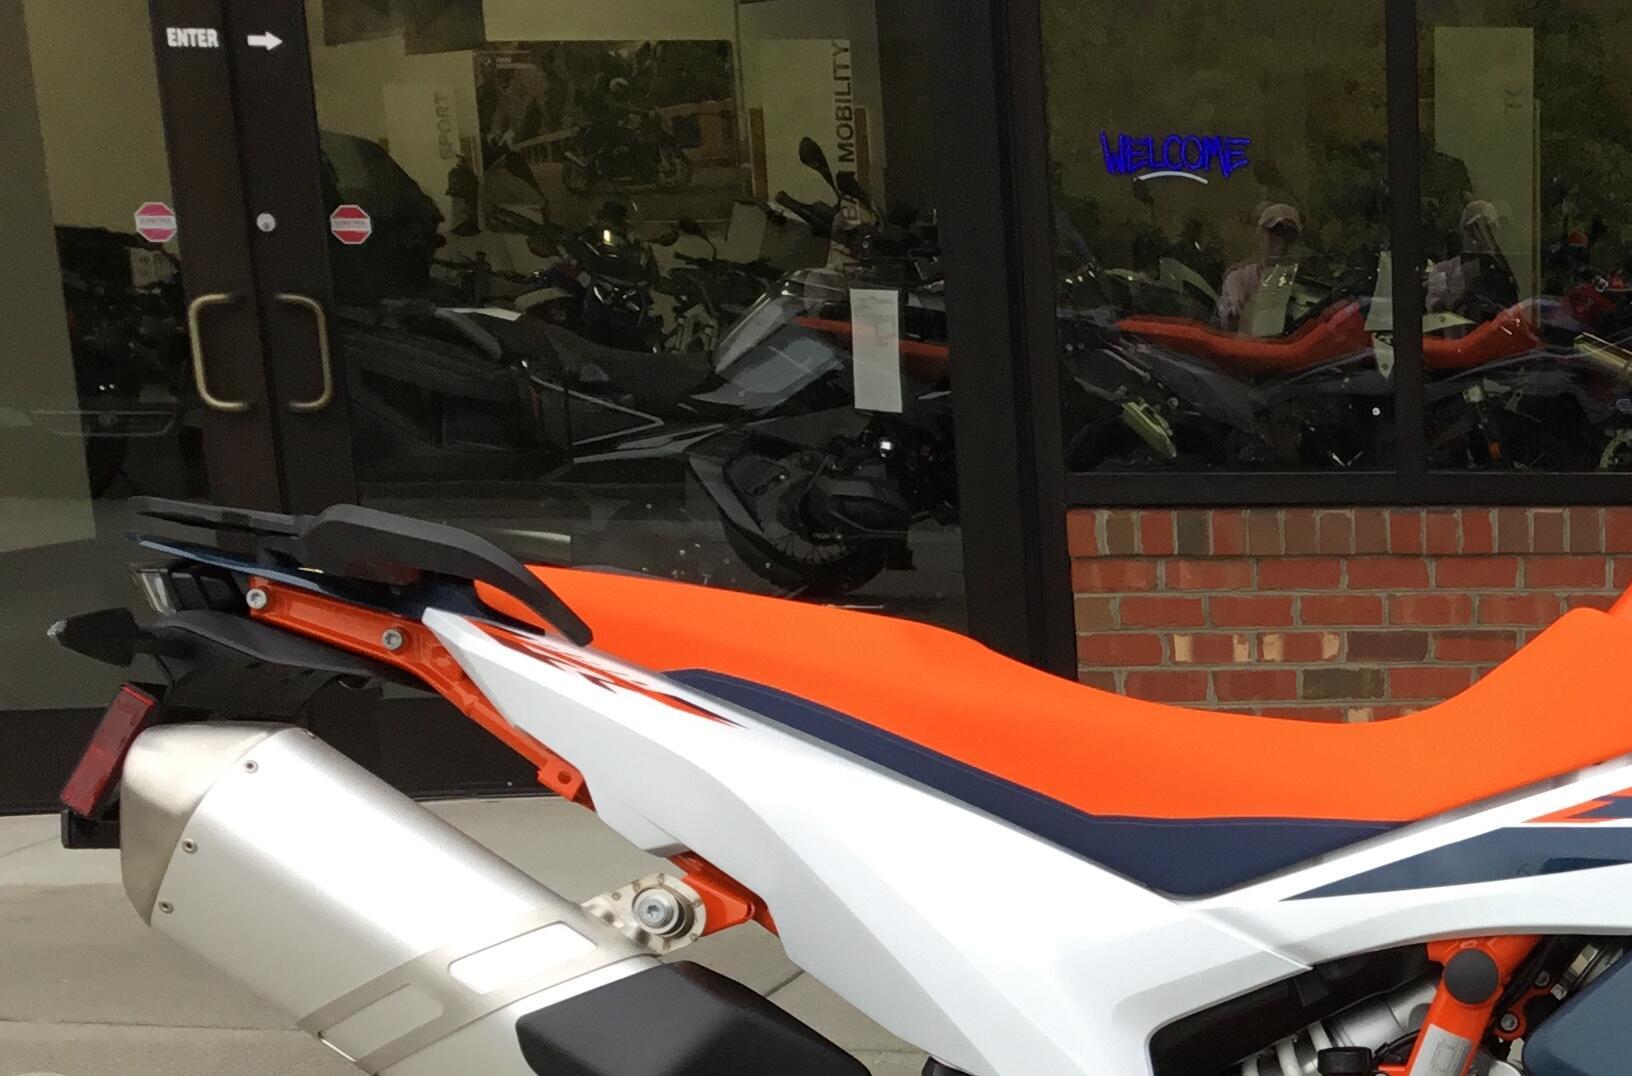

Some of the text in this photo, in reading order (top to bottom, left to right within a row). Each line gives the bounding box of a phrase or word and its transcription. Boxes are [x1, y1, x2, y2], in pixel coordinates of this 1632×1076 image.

[166, 27, 219, 48] ENTER
[433, 91, 452, 160] SPORT
[832, 40, 856, 163] MOBILITY
[1100, 130, 1251, 179] WELCOME
